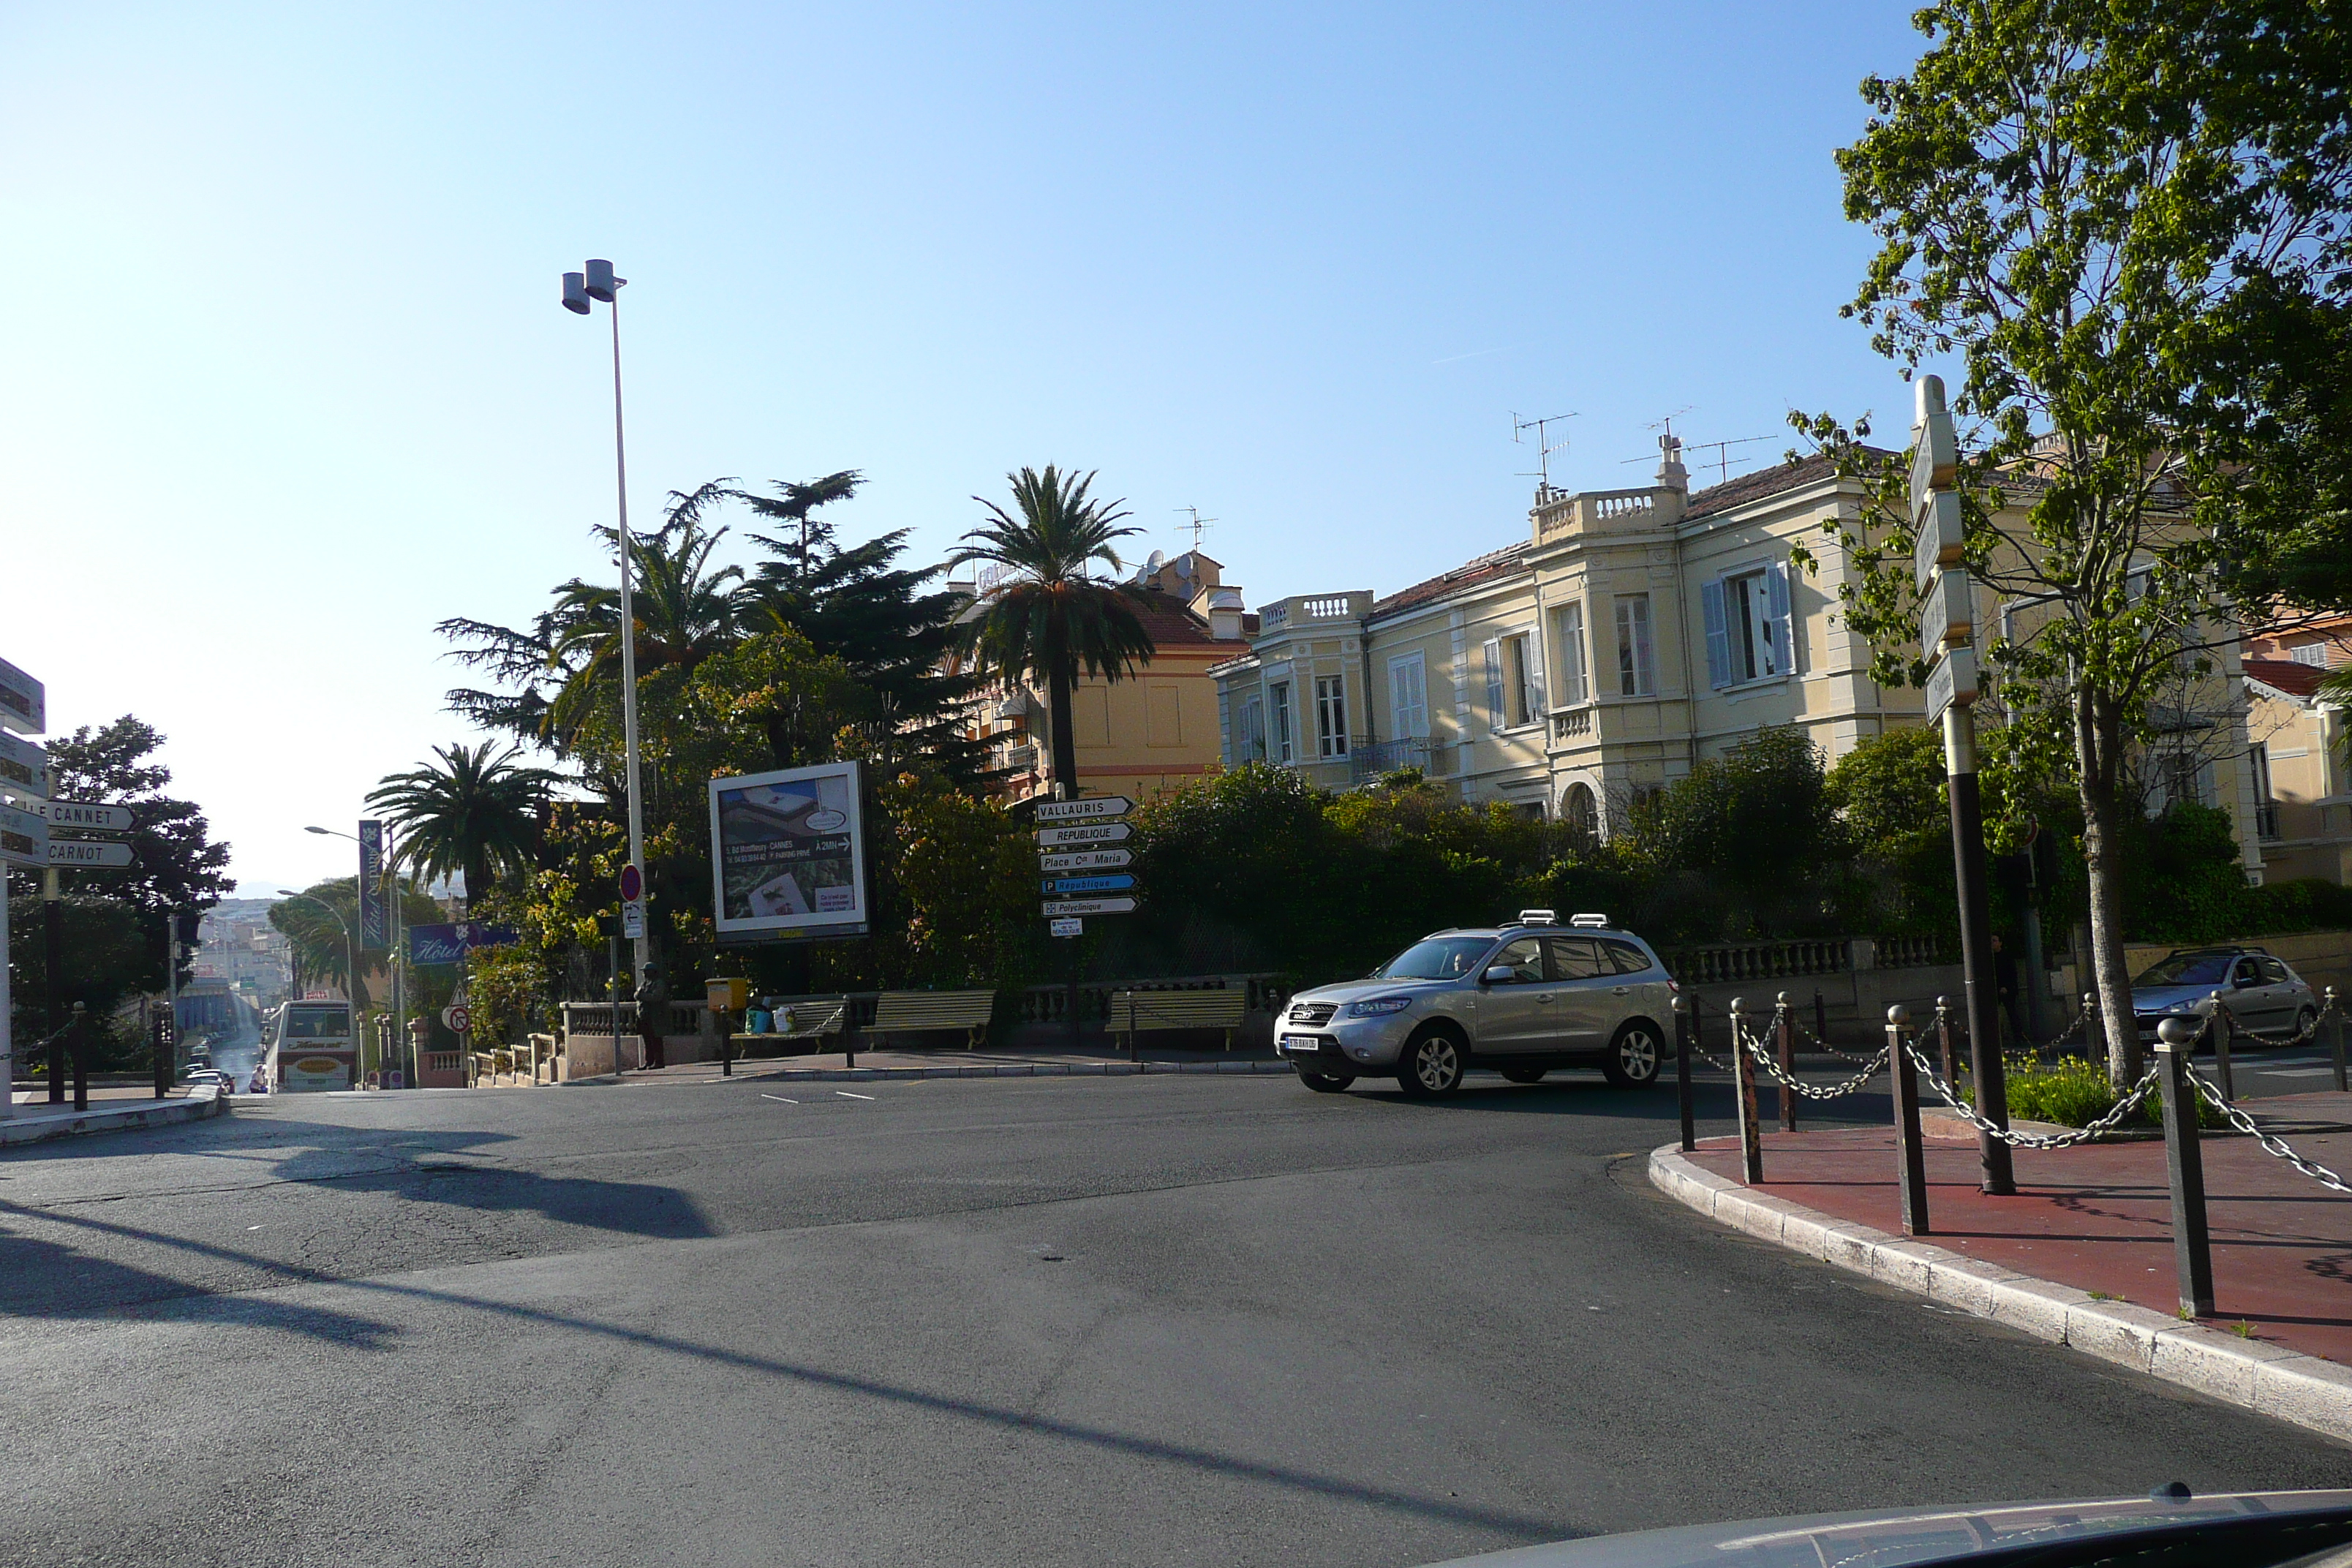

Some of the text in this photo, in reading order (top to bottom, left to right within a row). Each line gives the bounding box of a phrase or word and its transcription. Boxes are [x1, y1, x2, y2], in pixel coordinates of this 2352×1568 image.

[54, 807, 112, 824] CANNET
[1040, 802, 1104, 816] VALLAURIS
[1057, 828, 1111, 841] REPUBLIQUE
[769, 840, 793, 851] CANNES
[49, 845, 103, 861] CARNOT
[1044, 857, 1068, 867] Place
[1095, 853, 1120, 864] Maria
[1059, 902, 1101, 913] Polyclinique
[414, 938, 467, 962] Hôtel
